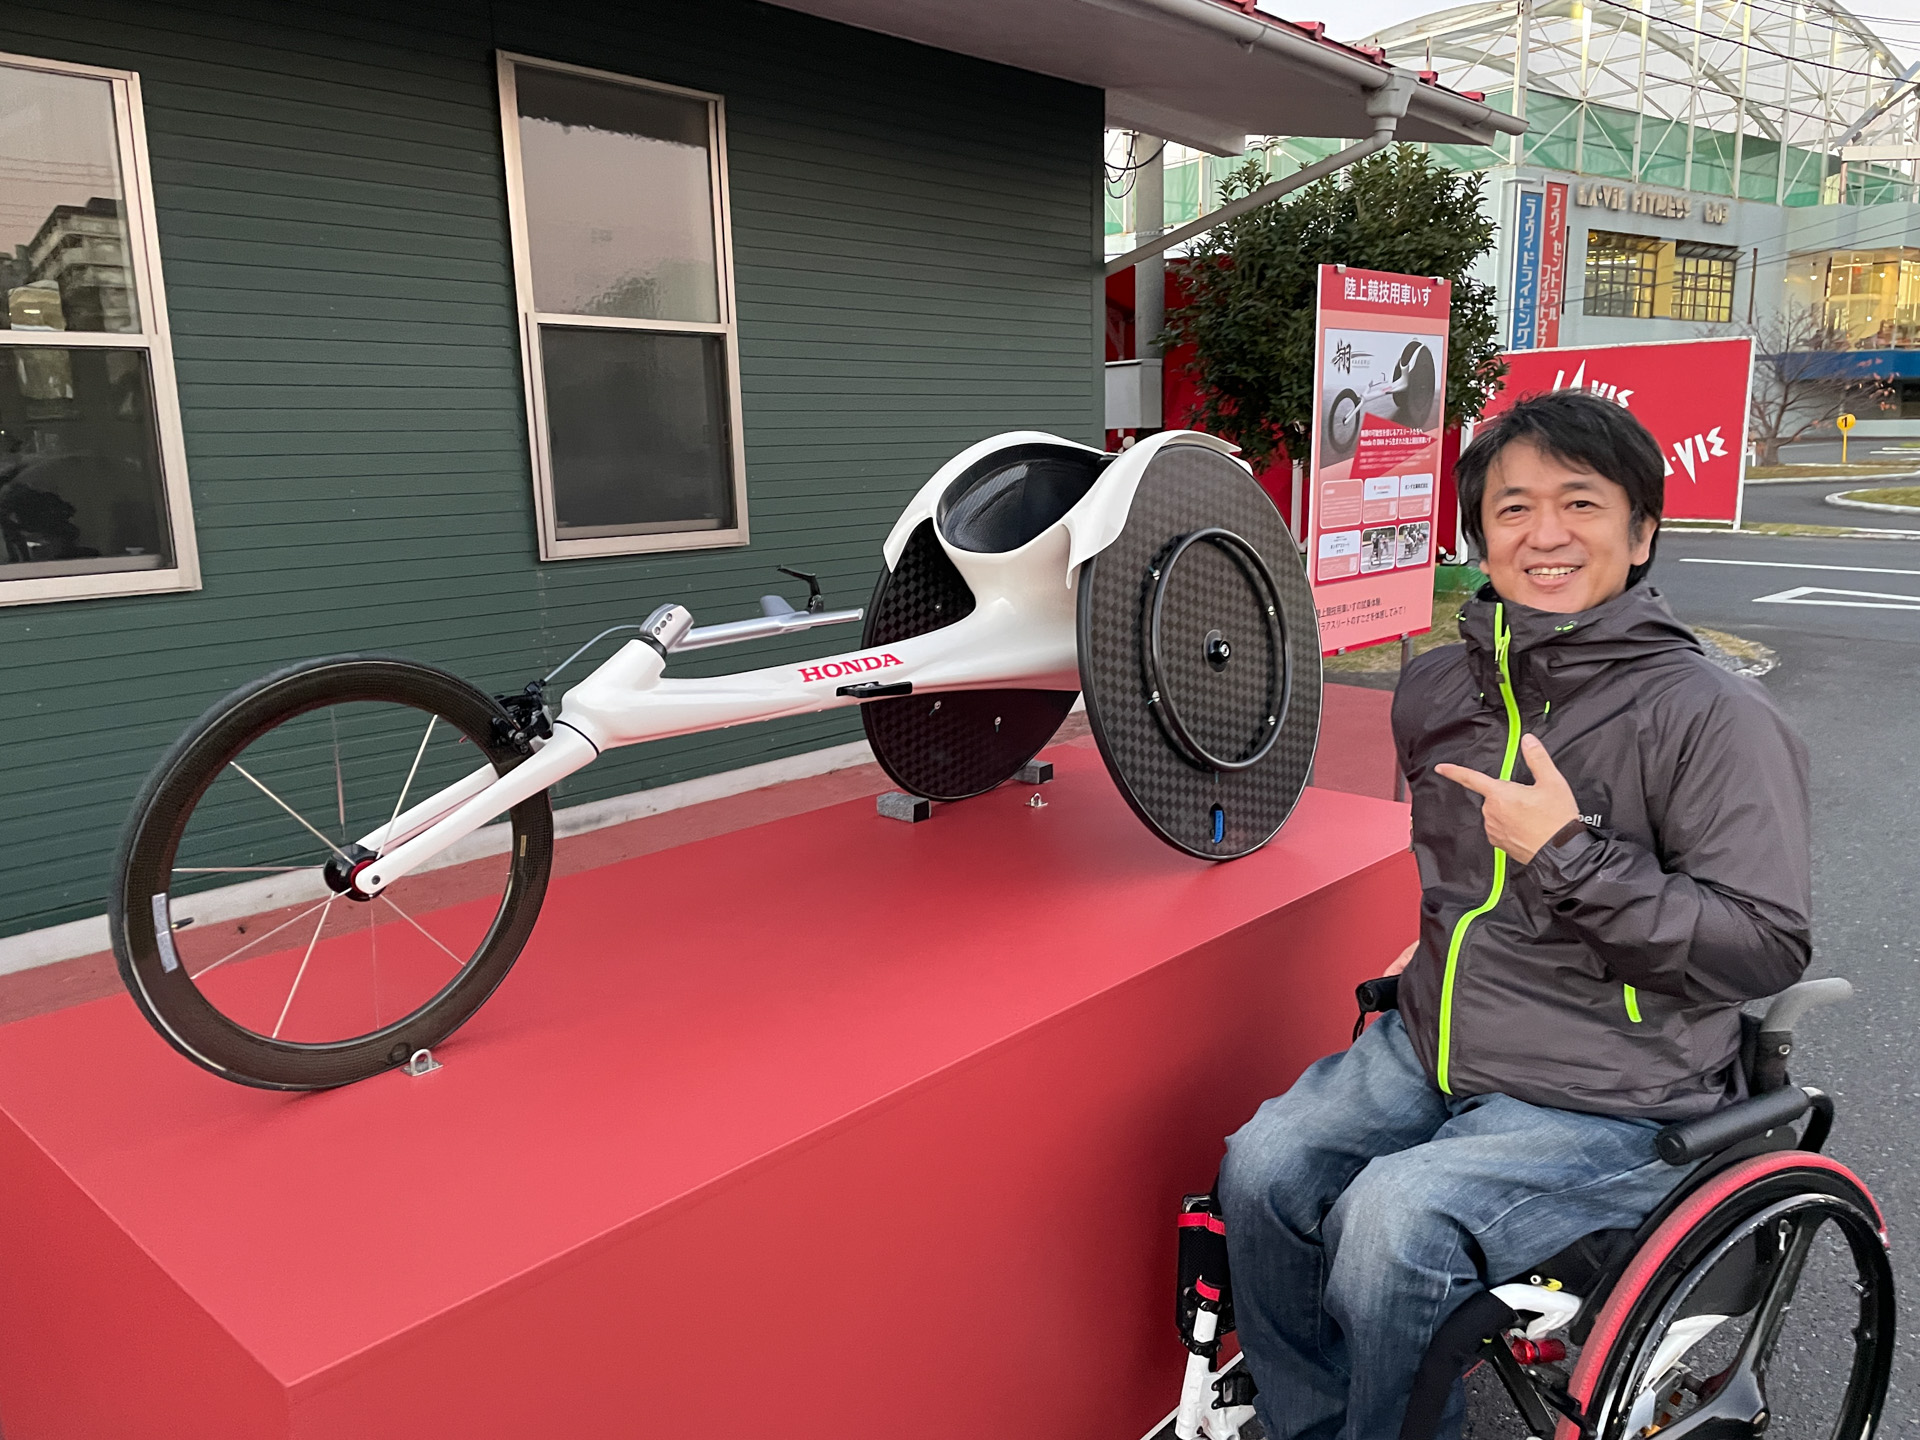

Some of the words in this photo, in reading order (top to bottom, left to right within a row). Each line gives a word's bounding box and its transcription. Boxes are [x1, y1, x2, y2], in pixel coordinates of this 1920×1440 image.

[1344, 277, 1431, 307] 陸上競技用車いす
[797, 653, 904, 683] HONDA
